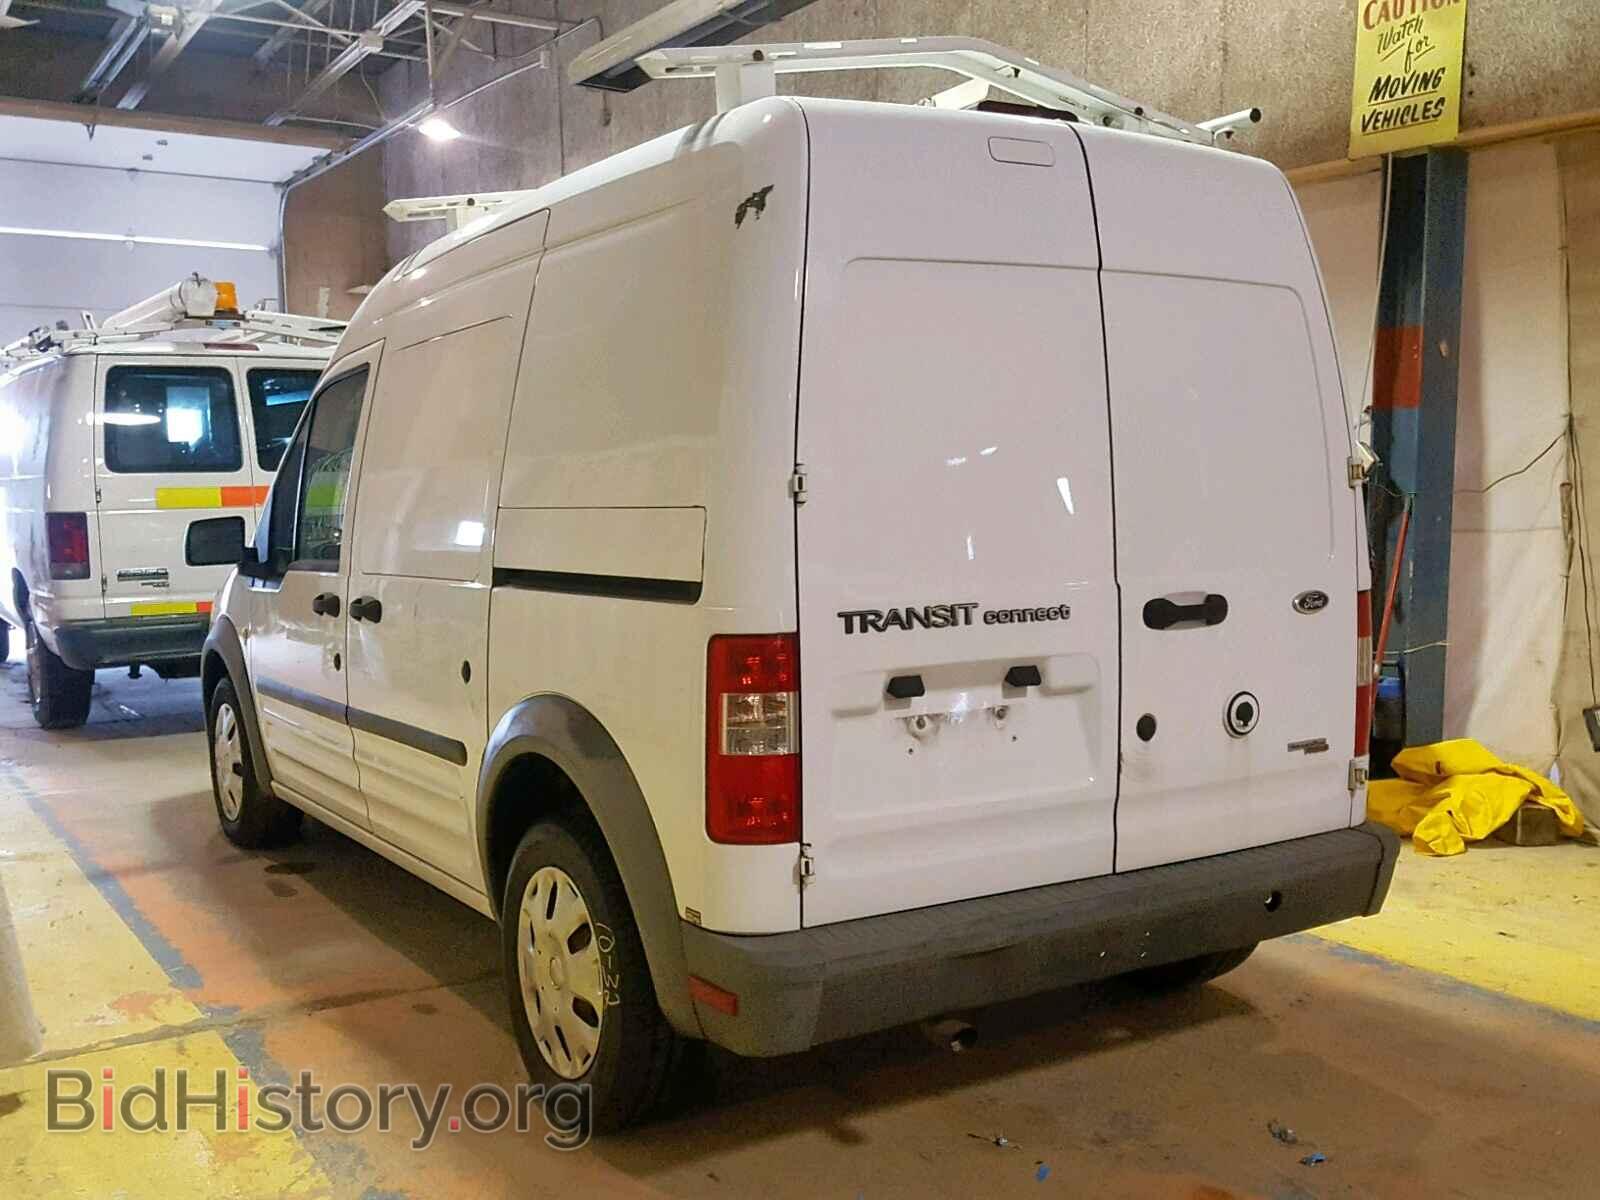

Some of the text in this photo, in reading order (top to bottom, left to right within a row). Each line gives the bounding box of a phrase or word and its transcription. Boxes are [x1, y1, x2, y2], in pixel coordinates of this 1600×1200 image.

[1377, 15, 1423, 54] Watch
[1404, 36, 1429, 74] for
[1368, 67, 1446, 103] MOVING
[1361, 97, 1446, 133] VEHICLES
[837, 602, 1071, 634] TRANSIT connect
